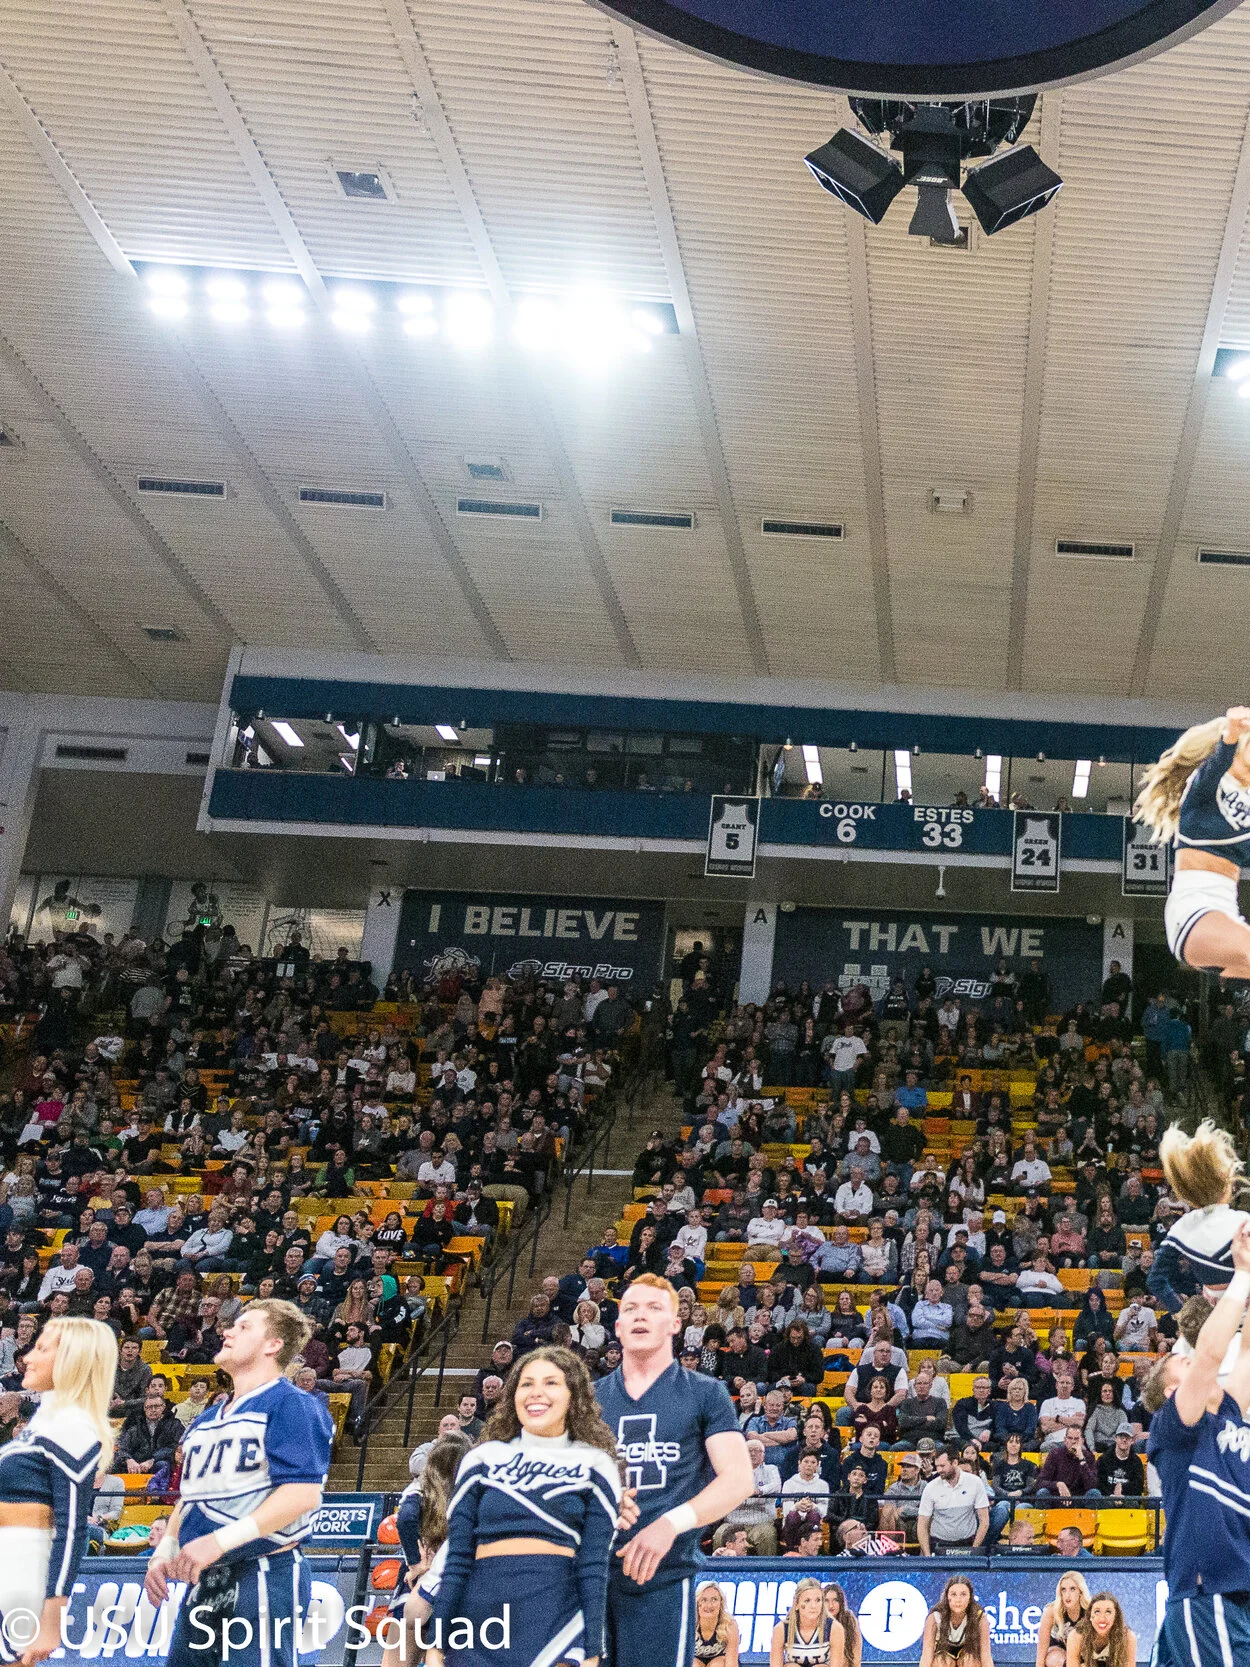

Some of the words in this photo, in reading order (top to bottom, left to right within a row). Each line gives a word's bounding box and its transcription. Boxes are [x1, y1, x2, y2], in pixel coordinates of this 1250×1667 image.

[819, 804, 877, 820] COOK
[914, 807, 974, 824] ESTES
[837, 818, 857, 843] 6
[922, 822, 963, 847] 33
[725, 833, 740, 850] 5
[1021, 848, 1051, 866] 24
[1133, 853, 1159, 871] 31
[378, 891, 391, 907] X
[428, 905, 441, 933] I
[464, 906, 640, 941] BELIEVE
[753, 908, 768, 924] A
[842, 921, 958, 954] THAT
[981, 927, 1044, 957] WE
[1111, 924, 1126, 939] A
[592, 964, 633, 979] Pro
[378, 1229, 404, 1240] LOVE
[617, 1442, 681, 1462] GIES
[493, 1452, 585, 1486] Aggies
[319, 1509, 367, 1521] PORTS
[313, 1521, 351, 1532] WORK
[883, 1598, 905, 1633] F
[983, 1591, 1041, 1630] she
